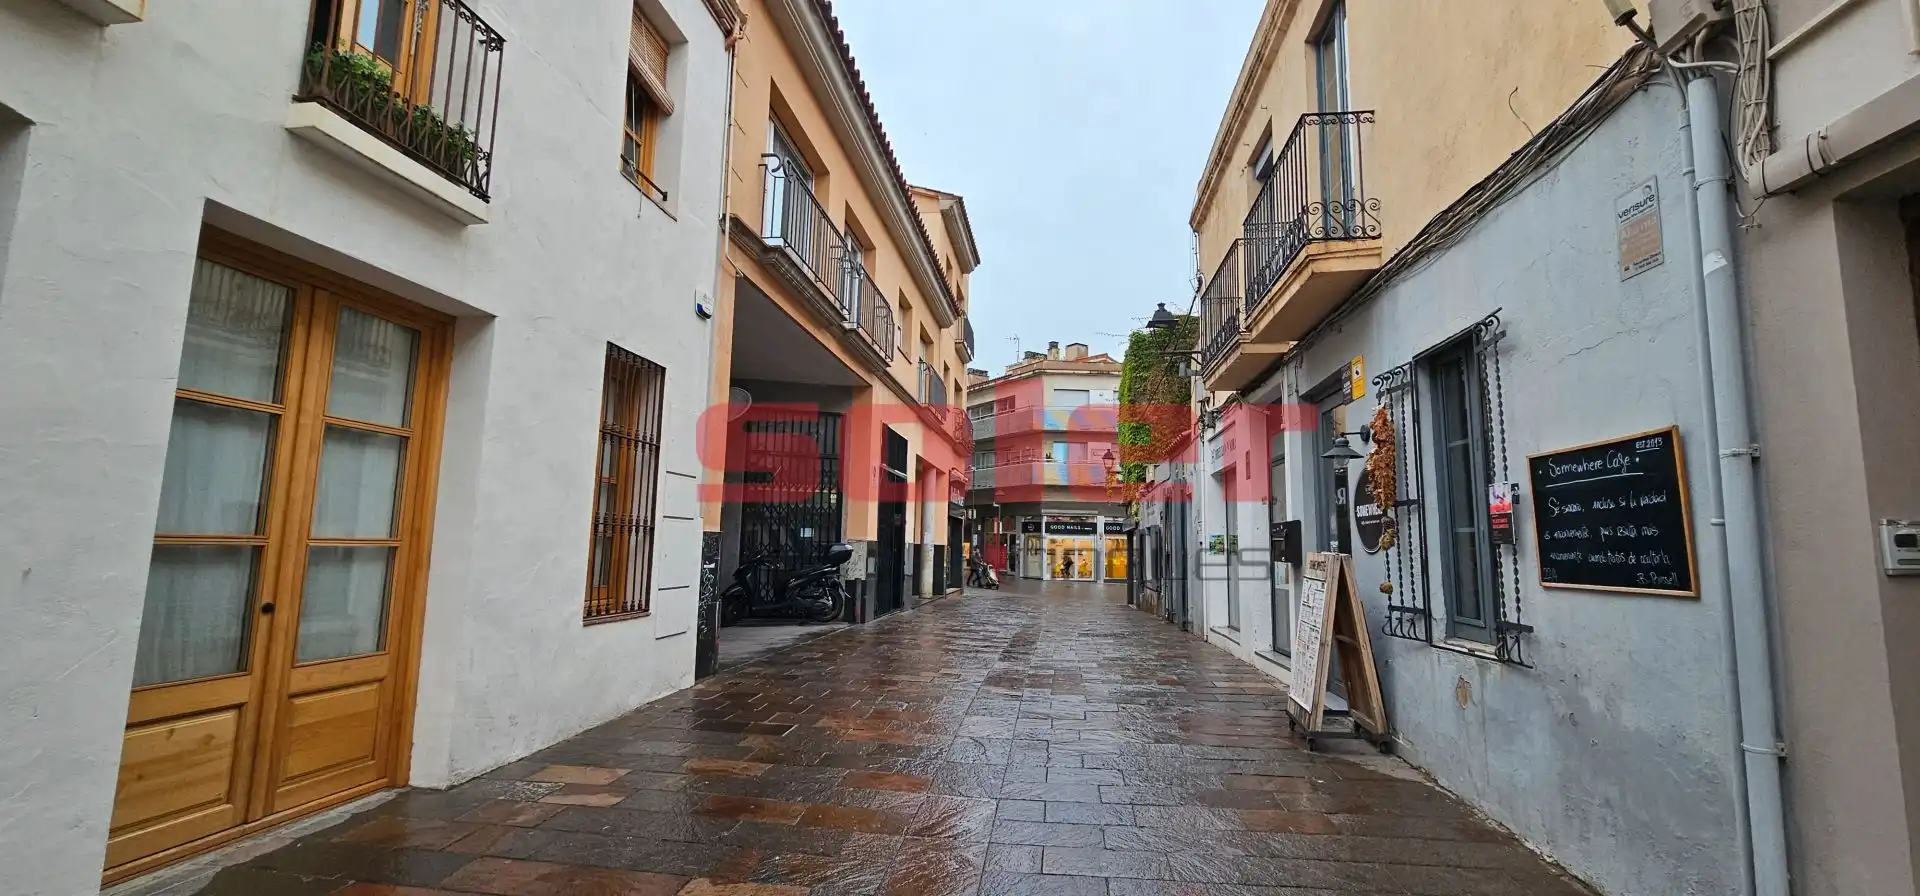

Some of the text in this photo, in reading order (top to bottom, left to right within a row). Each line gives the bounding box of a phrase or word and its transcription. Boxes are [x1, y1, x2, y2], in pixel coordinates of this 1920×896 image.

[1617, 194, 1656, 219] verisure
[1549, 457, 1604, 478] Somewhere
[1105, 524, 1121, 532] GOOD
